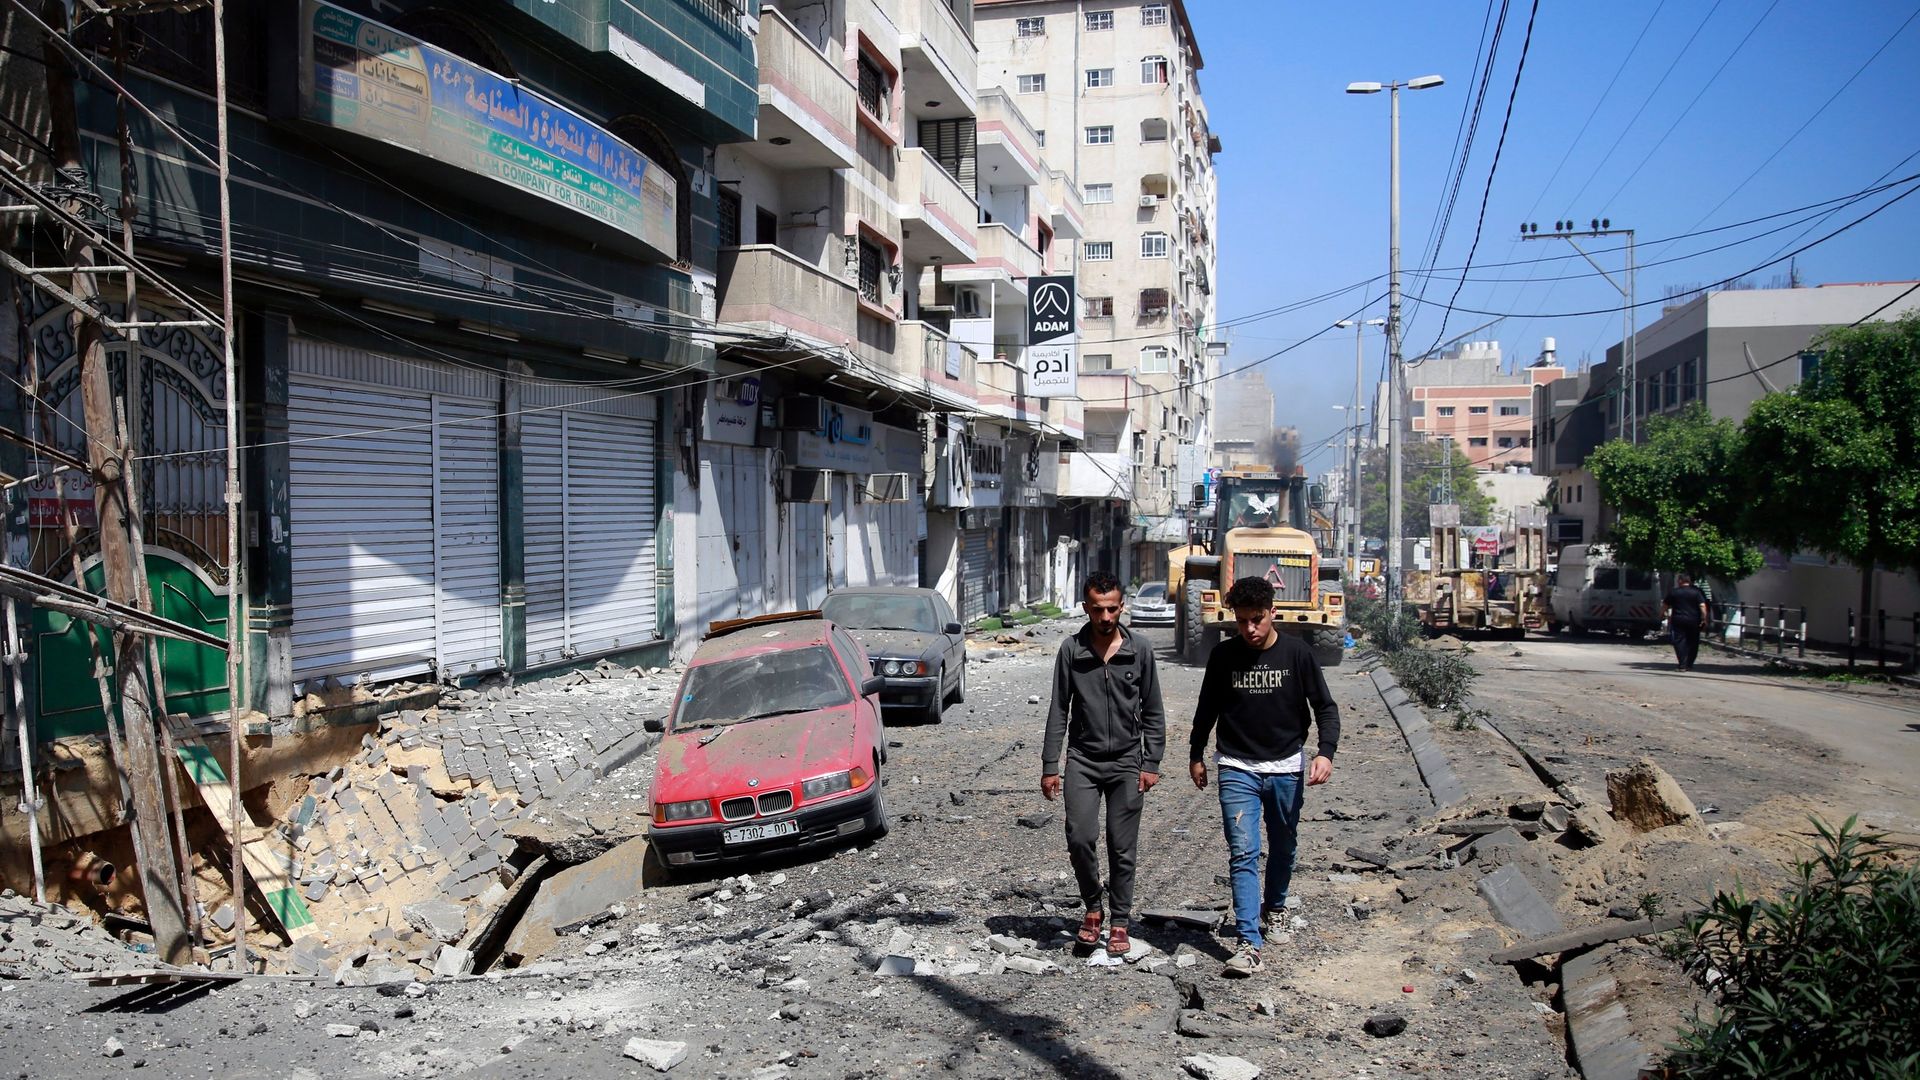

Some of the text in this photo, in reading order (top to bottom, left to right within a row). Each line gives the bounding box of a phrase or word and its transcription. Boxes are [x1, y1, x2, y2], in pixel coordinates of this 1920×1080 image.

[541, 109, 585, 156] للتجارة
[587, 132, 603, 166] الله
[604, 148, 618, 180] رام
[618, 149, 641, 189] شركة
[503, 162, 551, 191] COMPANY
[555, 184, 571, 202] FOR
[575, 193, 608, 220] TRADING
[1034, 321, 1069, 332] ADAM
[1034, 348, 1070, 379] آدم
[741, 383, 760, 402] max
[1034, 377, 1069, 387] للتجميل
[1360, 561, 1374, 572] CAT
[1232, 669, 1291, 688] BLEECKER ST.
